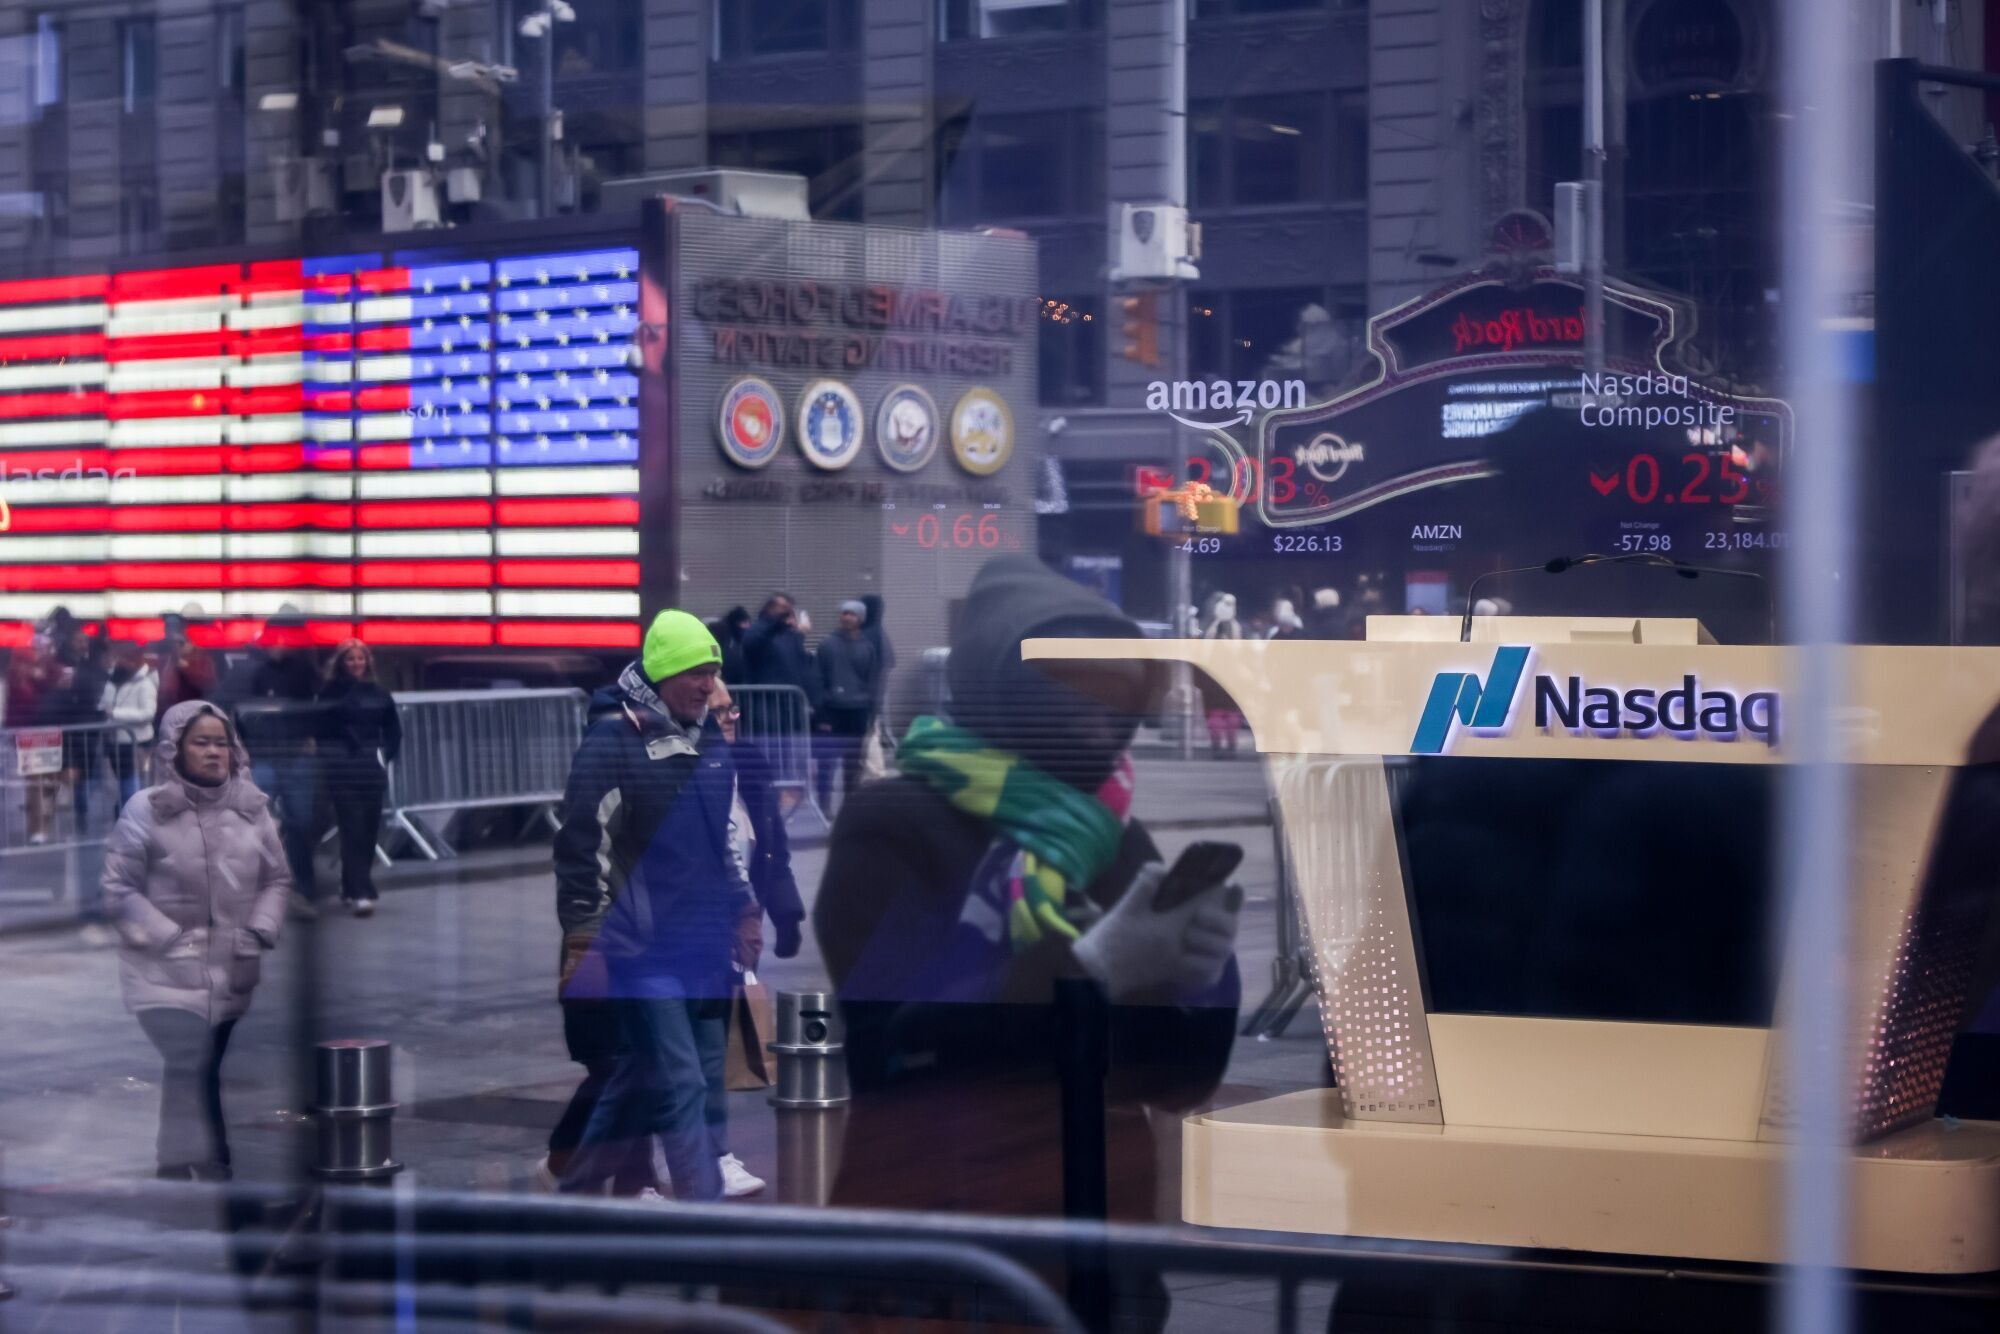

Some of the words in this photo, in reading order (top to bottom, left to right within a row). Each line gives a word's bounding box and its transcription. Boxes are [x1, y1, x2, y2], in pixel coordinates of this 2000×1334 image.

[1146, 378, 1306, 410] amazon
[1581, 370, 1688, 398] Nasdaq
[1580, 401, 1735, 429] Composite
[0, 458, 137, 503] asdaq
[1174, 537, 1221, 554] -4.69
[1273, 533, 1343, 553] $226.13
[1411, 524, 1462, 539] AMZN
[1613, 534, 1672, 552] -57.98
[1535, 674, 1780, 748] Nasdaq
